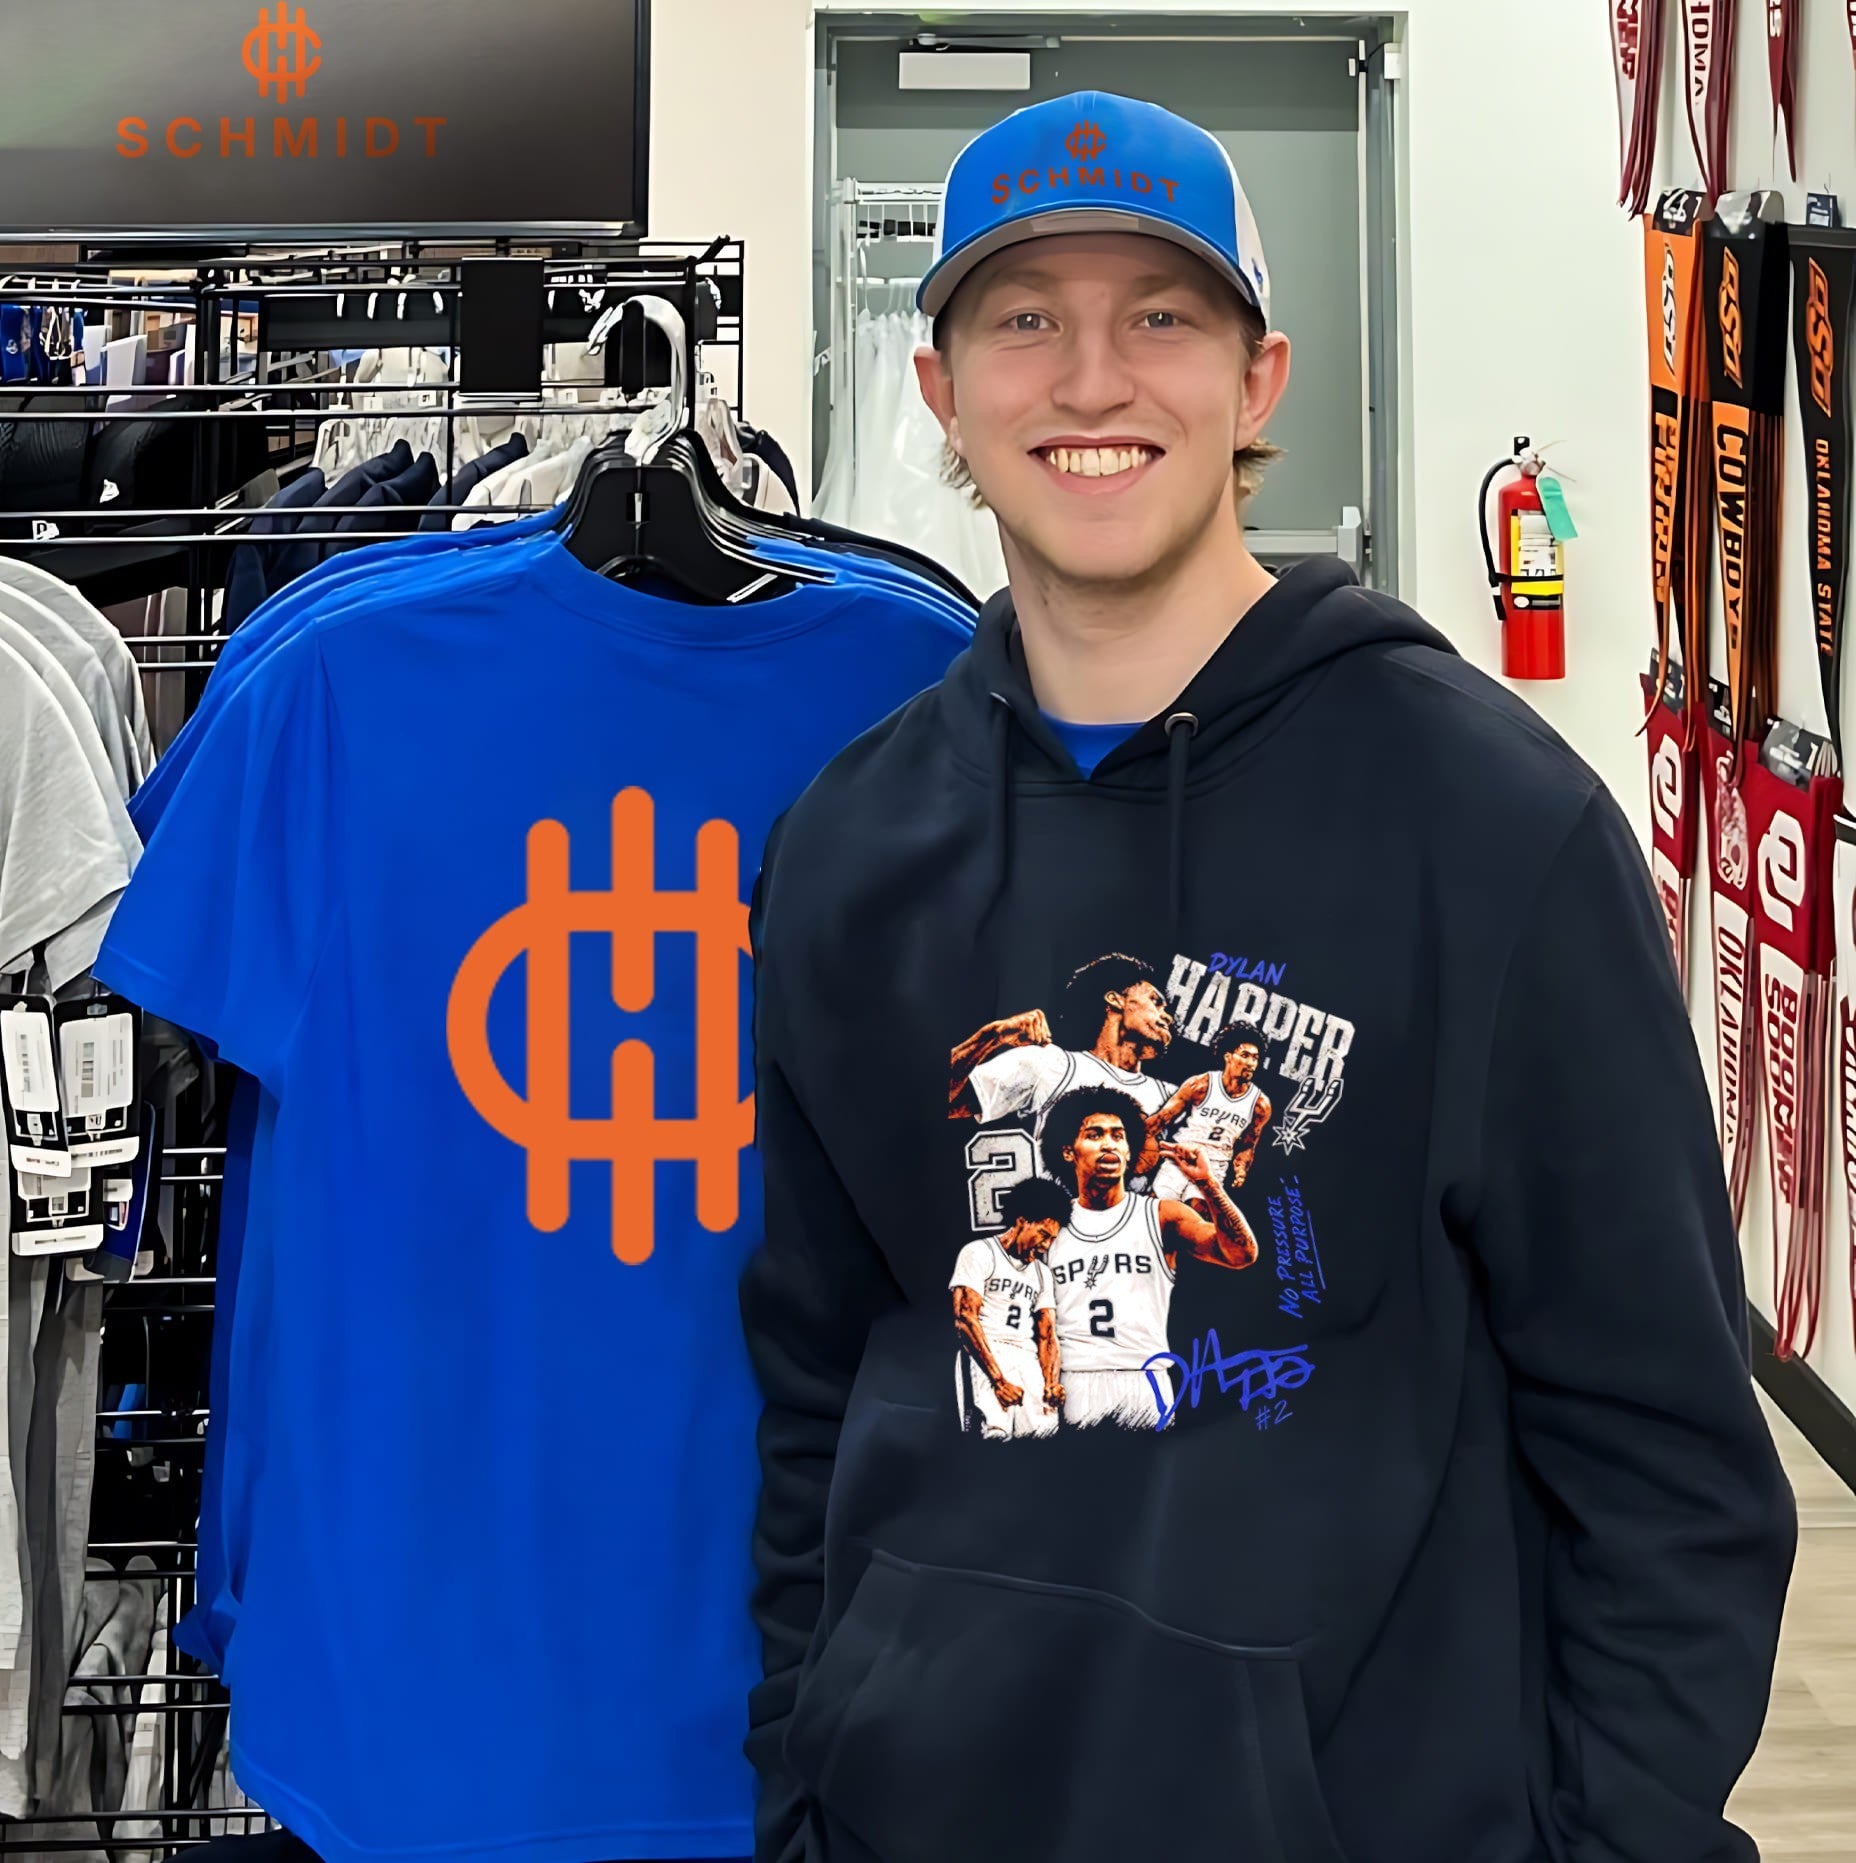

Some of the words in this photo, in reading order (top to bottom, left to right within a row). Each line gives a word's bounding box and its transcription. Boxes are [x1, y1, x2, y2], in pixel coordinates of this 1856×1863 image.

[116, 117, 447, 158] SCHMIDT
[992, 167, 1179, 205] SCHMIDT
[1815, 438, 1831, 570] OKLAHOMA
[1757, 810, 1805, 932] OU
[1208, 952, 1286, 986] DYLAN
[1165, 953, 1356, 1091] HARPER
[1200, 1107, 1247, 1129] SPURS
[1208, 1126, 1225, 1141] 2
[965, 1128, 1038, 1231] 2
[1052, 1253, 1151, 1289] SPURS
[1300, 1271, 1321, 1304] ALL
[1006, 1305, 1021, 1329] 2
[1089, 1299, 1115, 1338] 2
[1278, 1288, 1303, 1318] NO
[1254, 1399, 1294, 1431] #2
